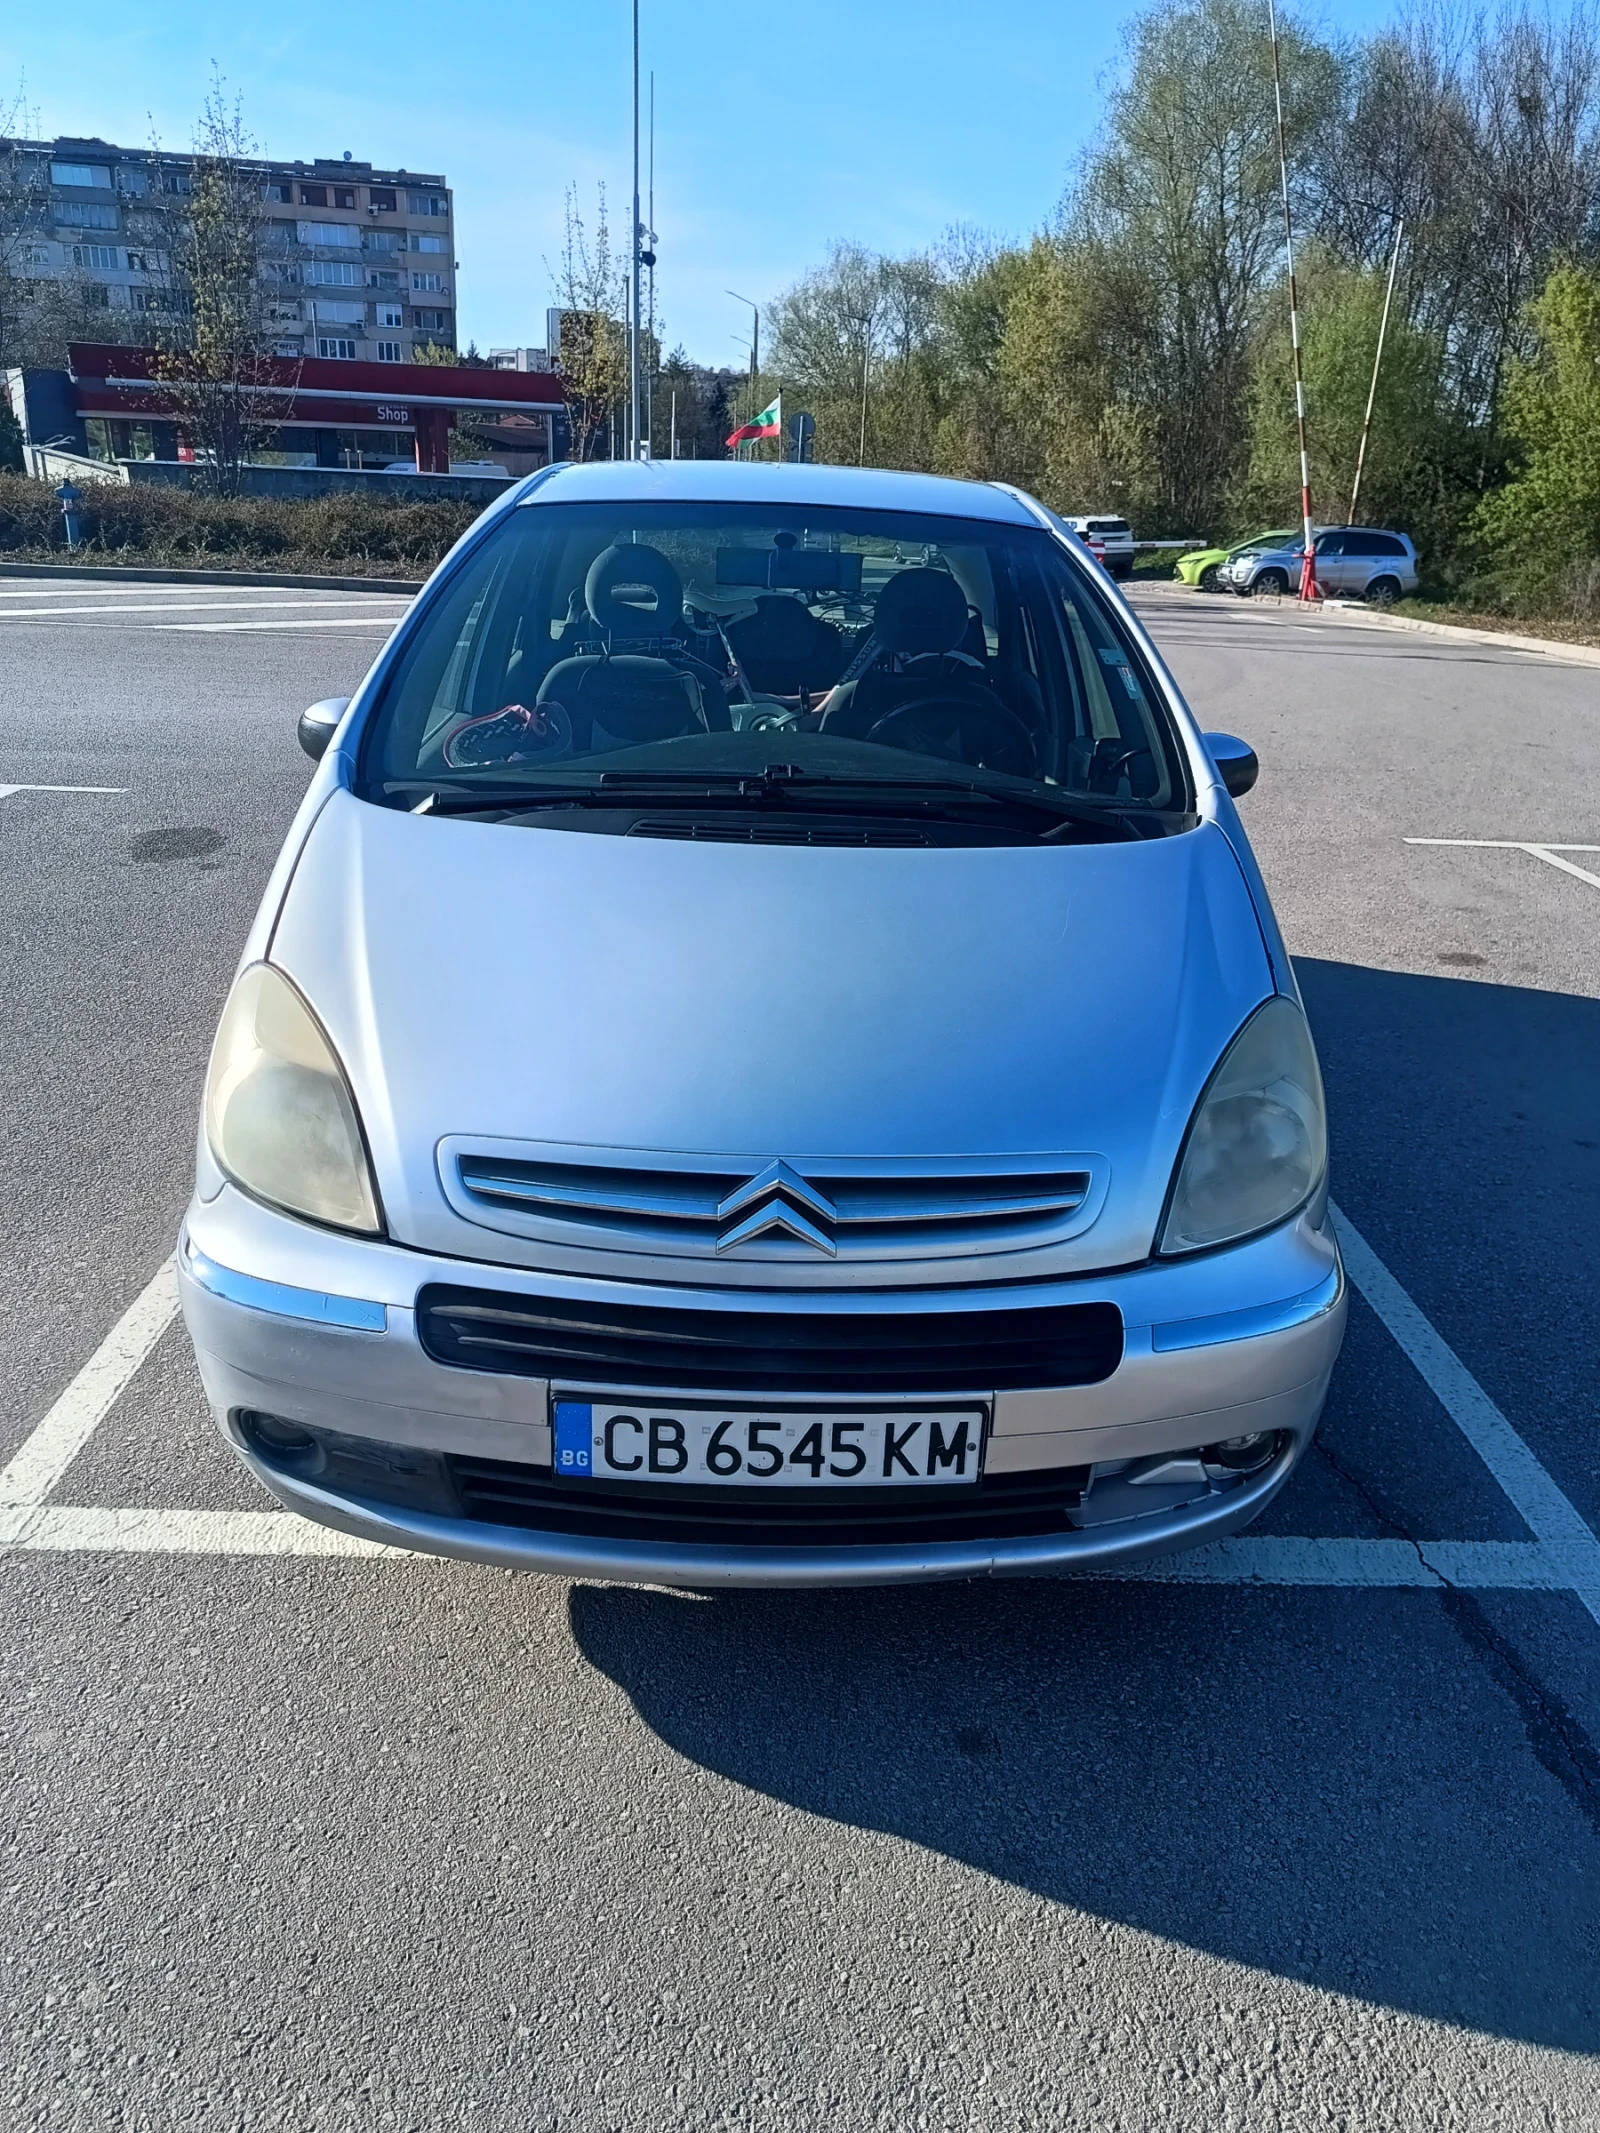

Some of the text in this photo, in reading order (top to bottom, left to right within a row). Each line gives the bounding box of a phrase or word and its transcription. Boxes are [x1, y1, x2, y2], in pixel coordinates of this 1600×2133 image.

[377, 406, 408, 424] Shop
[604, 1414, 970, 1478] CB 6545 KM
[561, 1449, 589, 1467] BG
